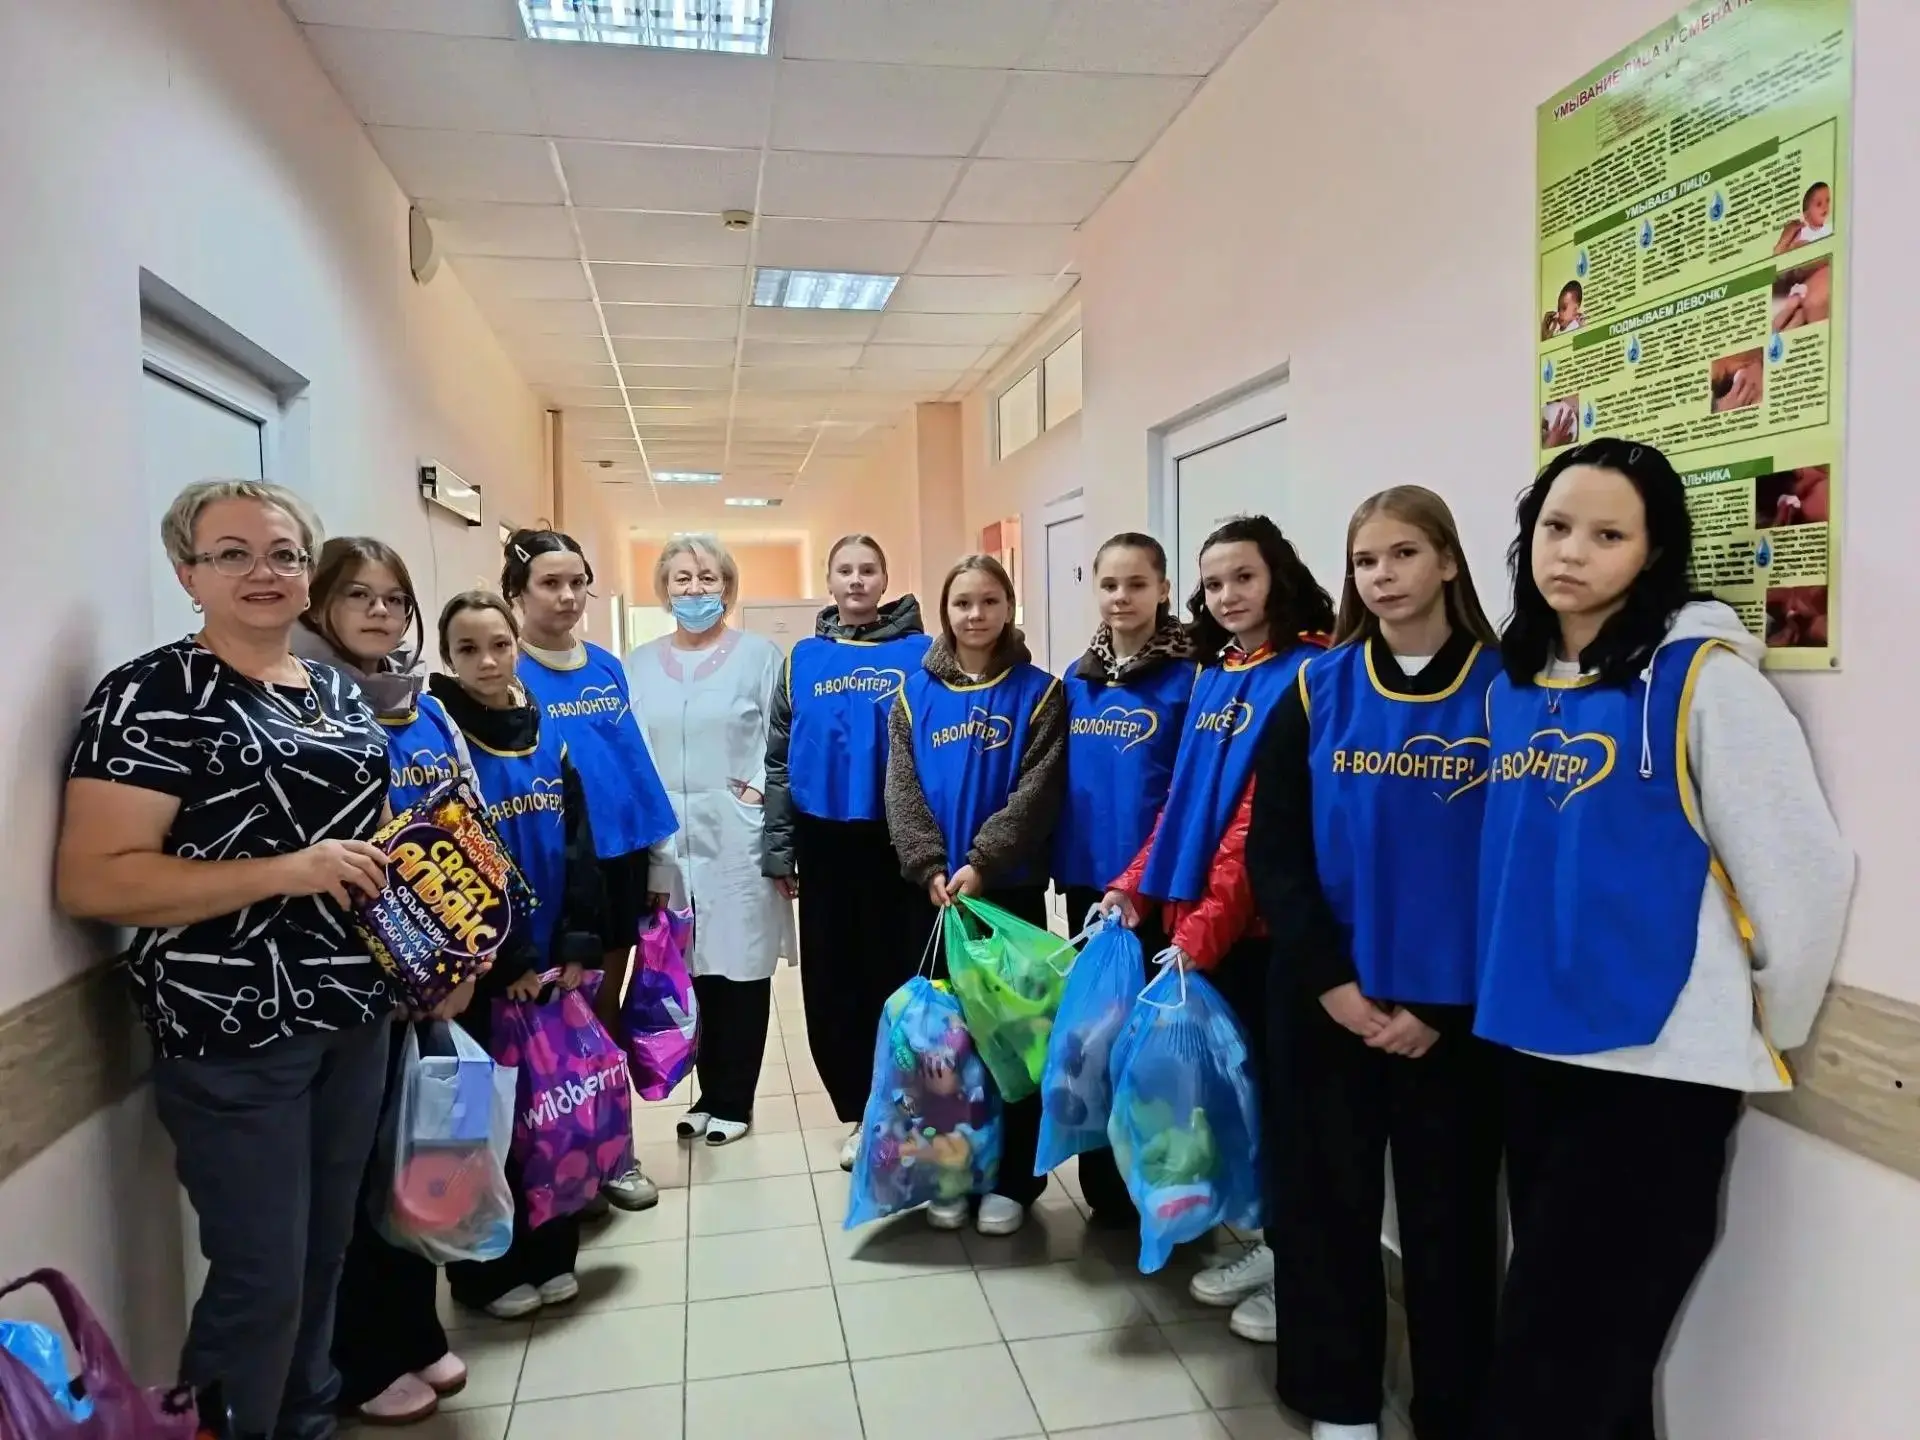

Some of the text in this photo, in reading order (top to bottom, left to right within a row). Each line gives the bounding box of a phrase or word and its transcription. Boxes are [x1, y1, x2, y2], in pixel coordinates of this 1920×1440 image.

[1553, 69, 1620, 121] УМЫВАНИЕ
[1625, 171, 1711, 220] УМЫВАЕМ ЛИЦО
[1641, 232, 1650, 246] 2
[1609, 285, 1728, 336] ПОДМЫВАЕМ ДЕВОЧКУ
[1681, 468, 1731, 486] АЛЬЧИКА
[547, 696, 622, 719] Я-ВОЛОНТЕР!
[814, 675, 892, 697] Я-ВОЛОНТЕР!
[1070, 717, 1141, 739] -ВОЛОНТЕР!
[1332, 750, 1475, 781] Я-ВОЛОНТЕР!
[388, 842, 498, 955] АЛЬЯНС
[430, 840, 500, 912] CRAZY
[397, 885, 449, 949] ОБЪЯСНЯЙ!
[372, 904, 431, 983] ИЗОБРАЖАЙ!
[523, 1054, 629, 1130] wildberri
